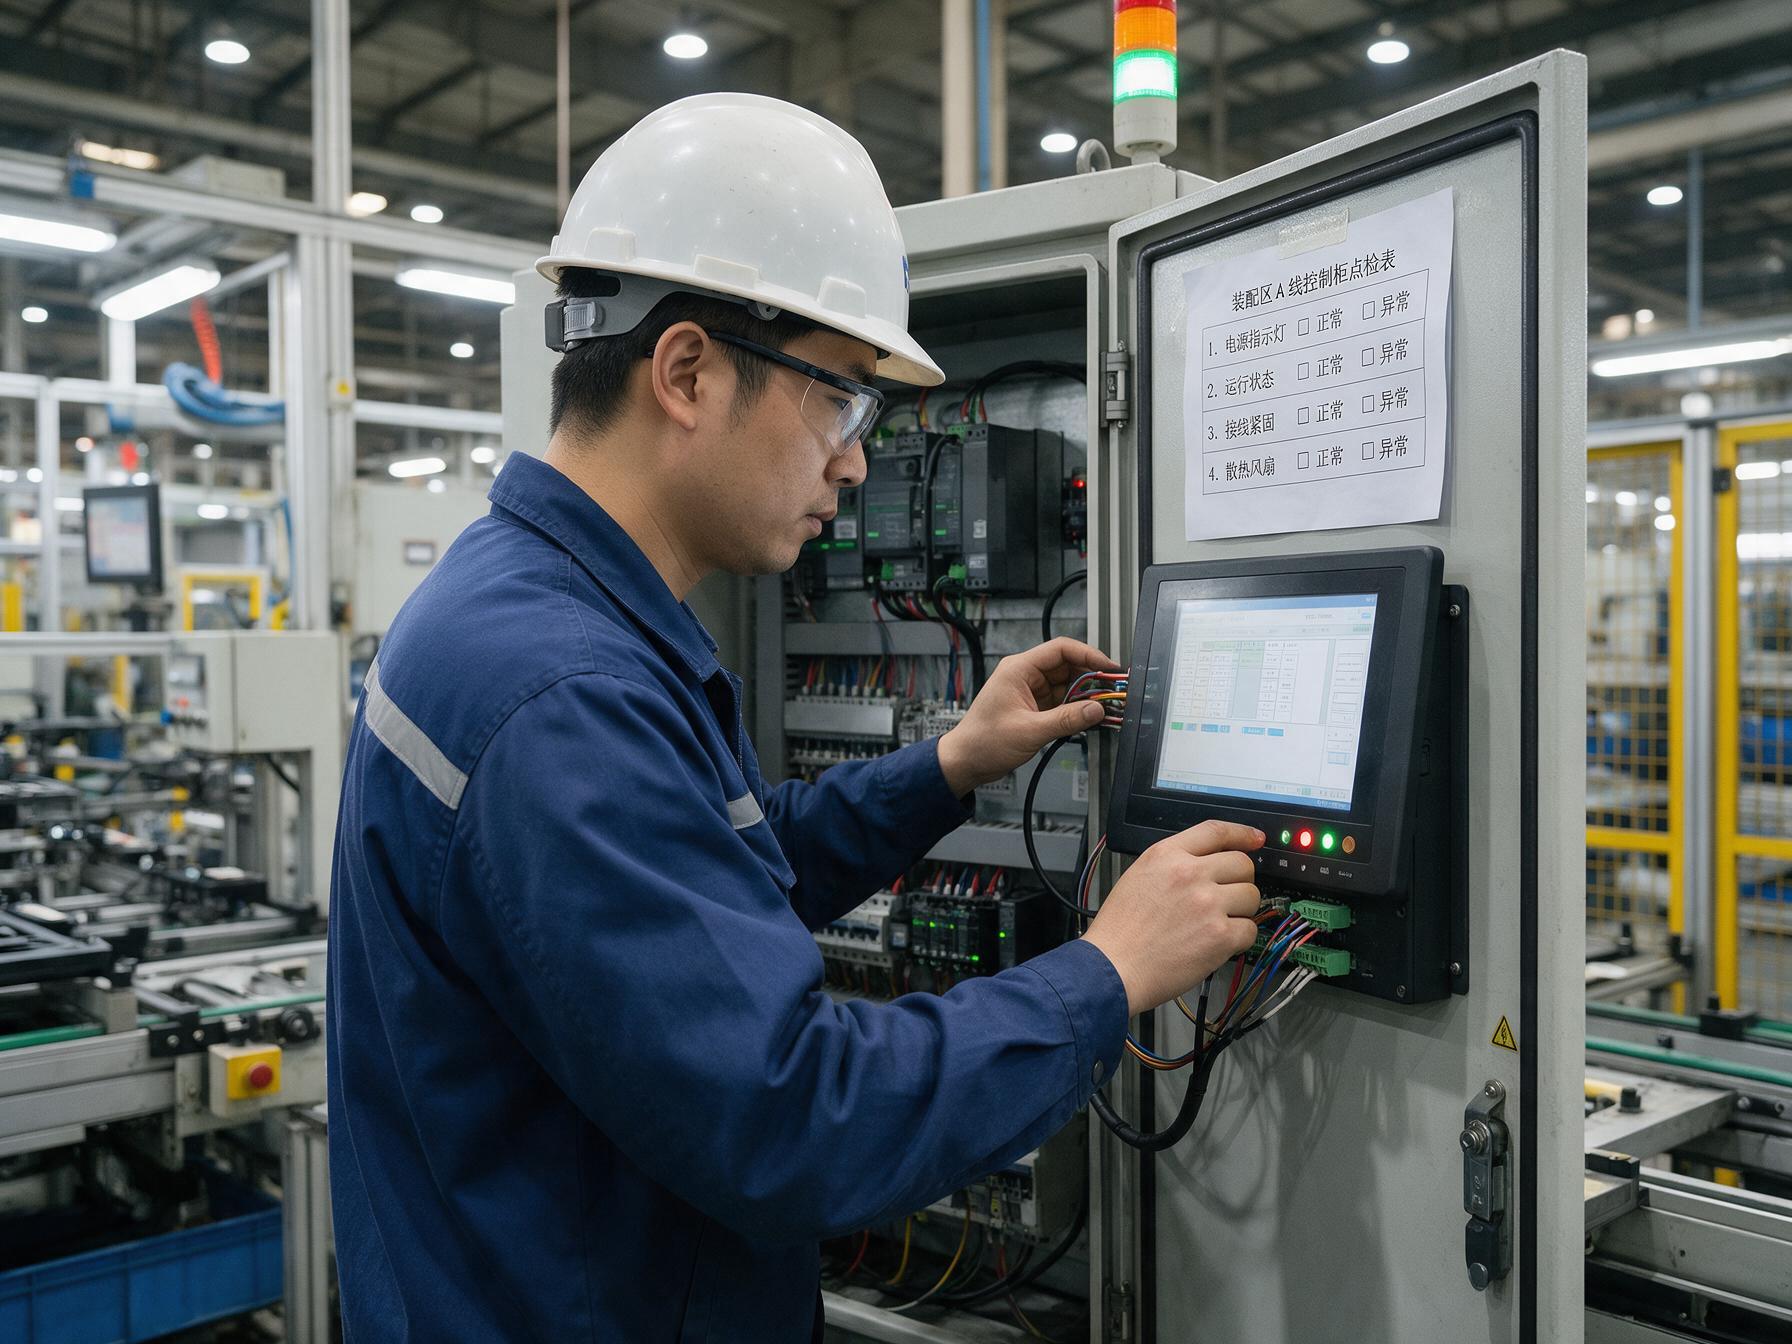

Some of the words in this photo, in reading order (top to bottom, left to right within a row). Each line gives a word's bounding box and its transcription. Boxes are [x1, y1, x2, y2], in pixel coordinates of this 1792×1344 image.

[1225, 323, 1287, 354] 电源指示灯
[1316, 308, 1343, 332] 正常
[1380, 290, 1410, 318] 异常
[1225, 369, 1275, 396] 运行状态
[1316, 354, 1343, 378] 正常
[1380, 338, 1409, 365] 异常
[1225, 413, 1275, 439] 接线紧固
[1316, 400, 1343, 423] 正常
[1380, 387, 1409, 413] 异常
[1226, 456, 1275, 481] 散热风扇
[1316, 446, 1343, 468] 正常
[1379, 435, 1409, 460] 异常
